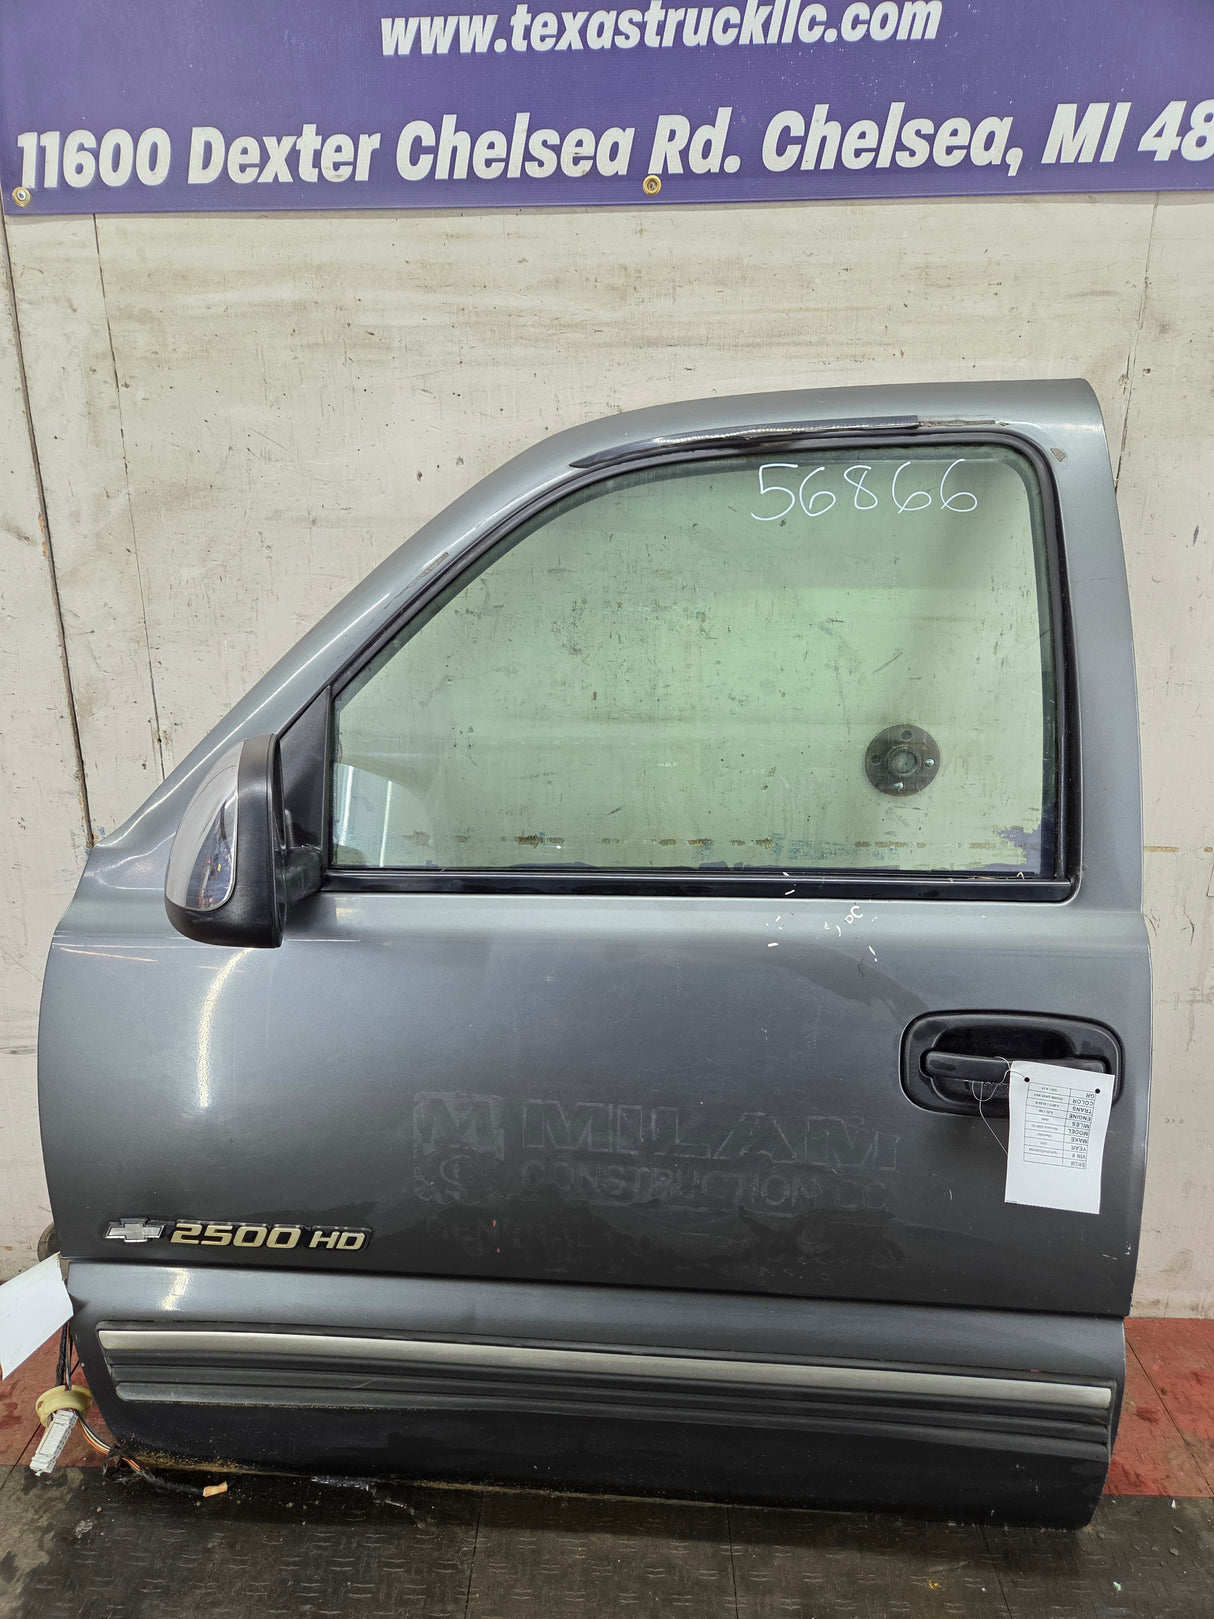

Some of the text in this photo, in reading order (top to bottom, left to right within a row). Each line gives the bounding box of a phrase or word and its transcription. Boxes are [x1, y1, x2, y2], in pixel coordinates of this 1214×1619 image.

[381, 0, 943, 56] www.texastruckllc.com
[17, 99, 1214, 188] 11600 Dexter Chelsea Rd. Chelsea, MI 48
[751, 458, 978, 521] 56866
[1069, 1113, 1092, 1121] ENGINE
[1072, 1106, 1092, 1114] TRANS
[1067, 1128, 1089, 1136] MODEL
[1071, 1121, 1090, 1129] MILES
[170, 1222, 367, 1250] 2500 HD
